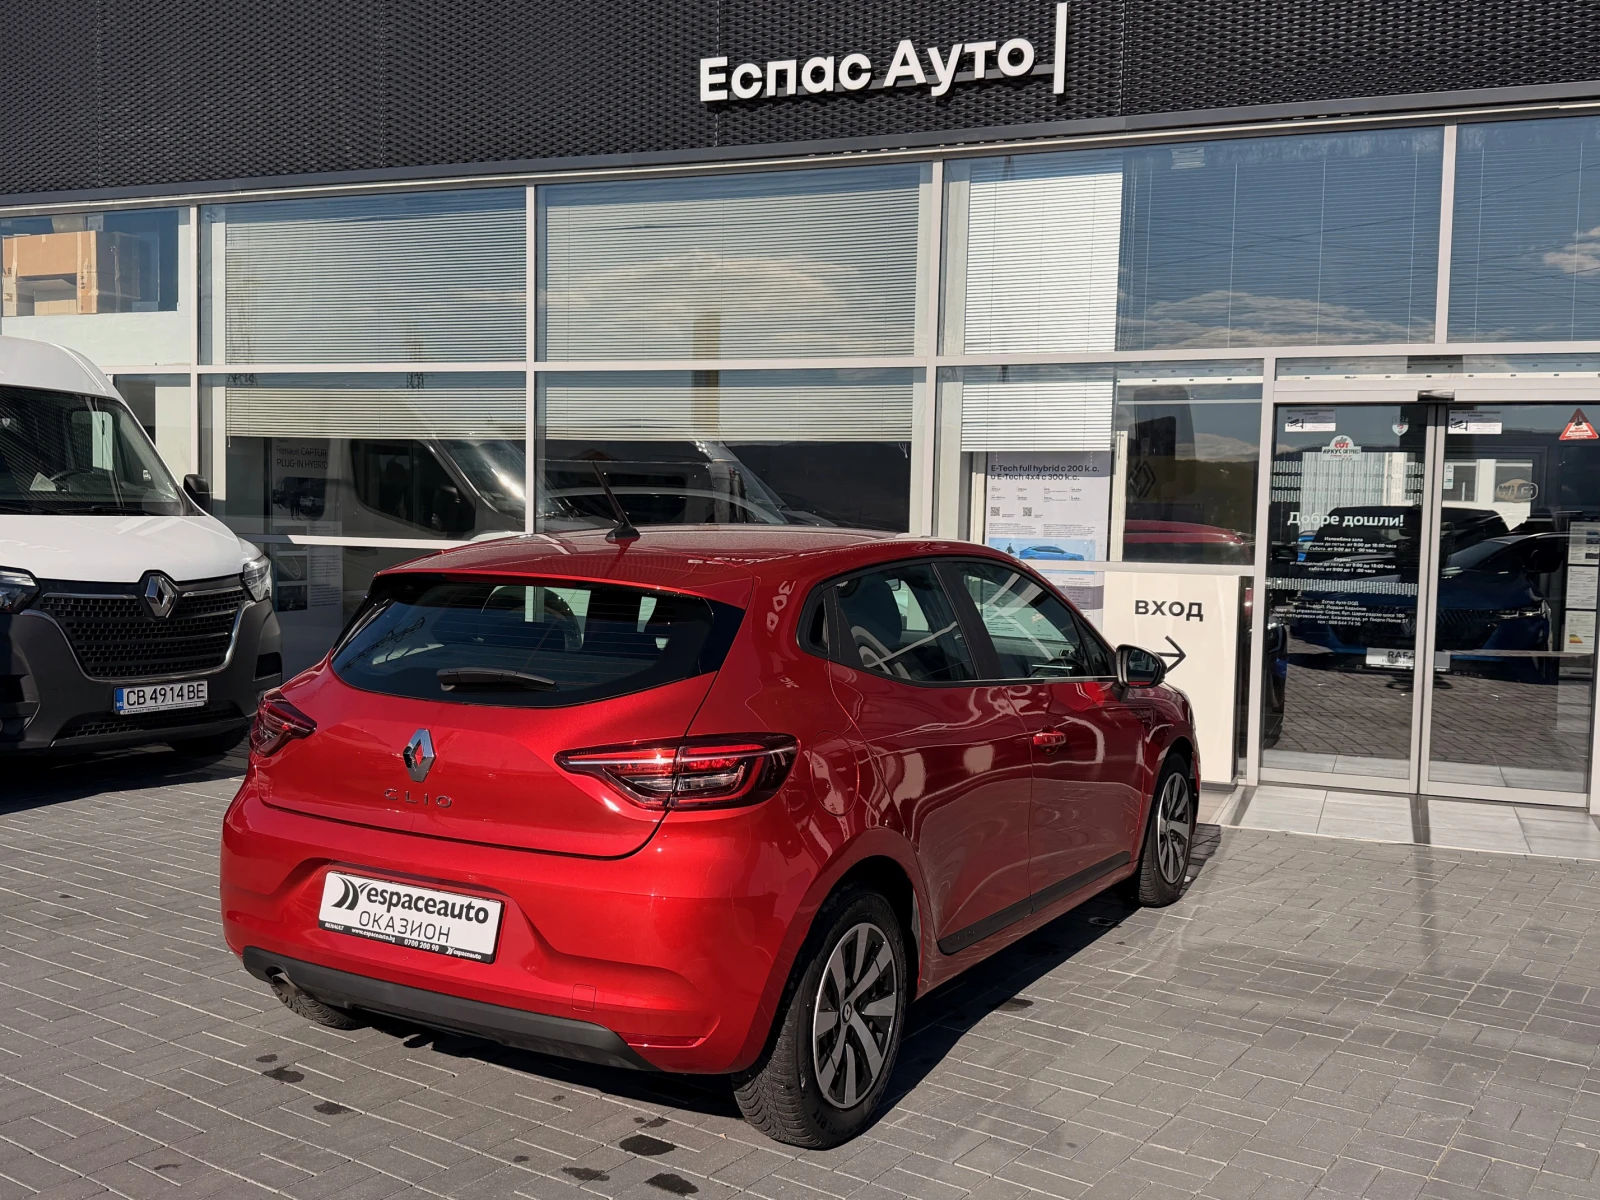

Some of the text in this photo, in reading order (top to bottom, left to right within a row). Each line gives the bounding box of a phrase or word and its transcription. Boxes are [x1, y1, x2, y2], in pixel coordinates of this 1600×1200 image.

[700, 38, 1035, 101] Еспас Ауто
[276, 458, 328, 470] PLUG-IN HYBRID
[1019, 464, 1033, 472] full
[1033, 465, 1060, 474] hybrid
[1287, 511, 1404, 527] Добре дошли!
[1134, 600, 1204, 622] ВХОД
[126, 689, 147, 706] CB
[149, 685, 184, 704] 4914
[187, 683, 205, 700] BE
[384, 788, 453, 808] CLIO
[366, 886, 489, 924] espaceauto
[358, 910, 451, 943] ОКАЗИОН
[324, 921, 482, 960] RENAULT www.espaceauto.bg 0700 200 90 espaceauto
